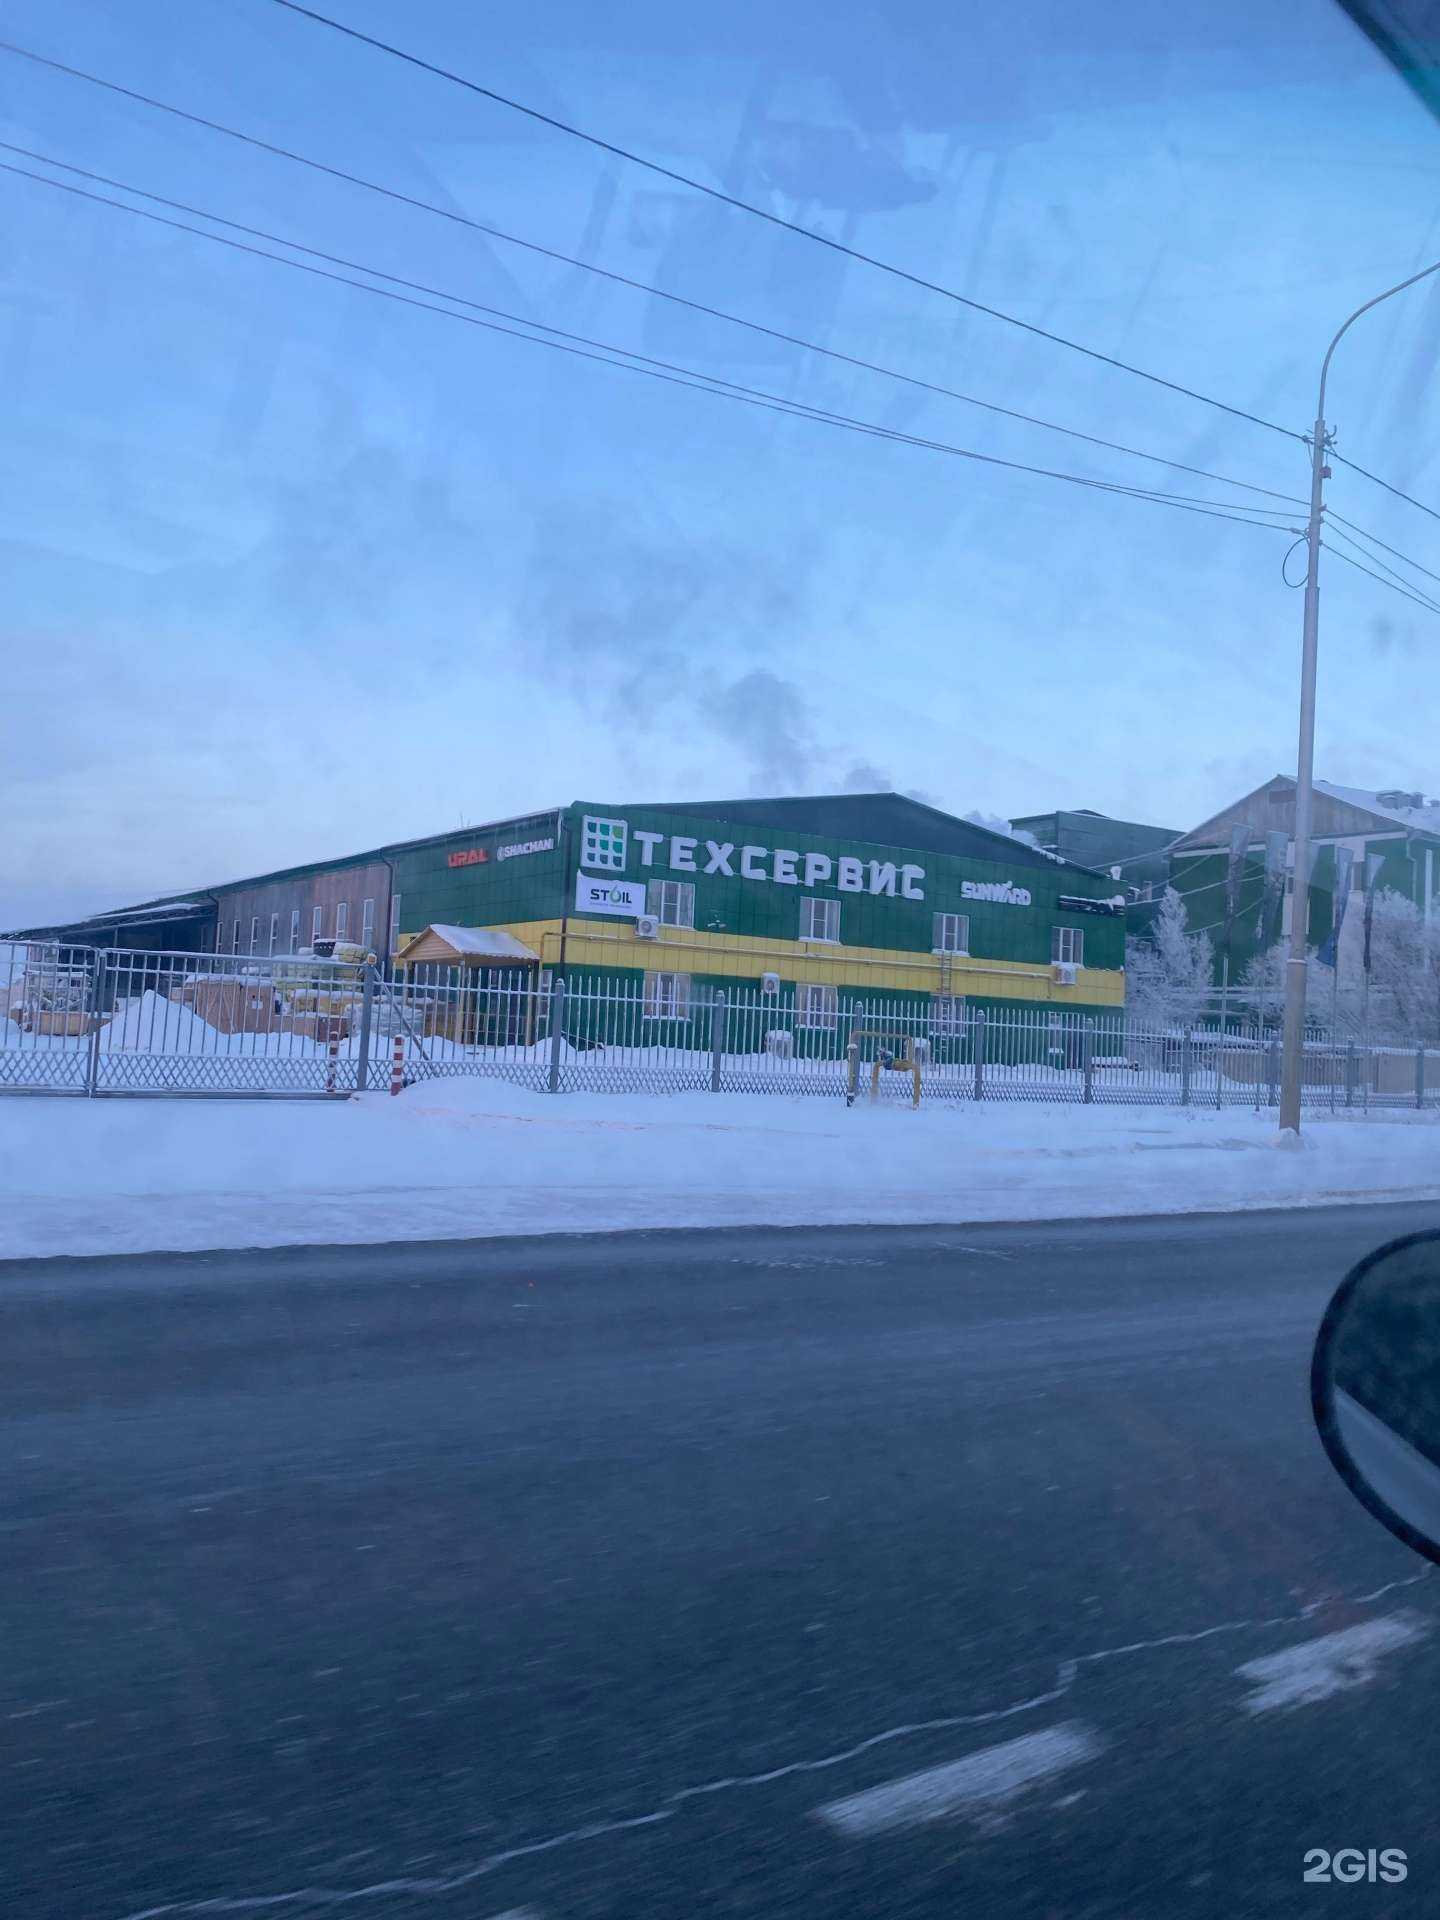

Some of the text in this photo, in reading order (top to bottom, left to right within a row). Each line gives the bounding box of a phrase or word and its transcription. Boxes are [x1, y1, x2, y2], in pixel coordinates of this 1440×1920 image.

[448, 848, 488, 868] URAL
[632, 829, 926, 901] ТЕХСЕРВИС
[590, 884, 632, 904] STOIL
